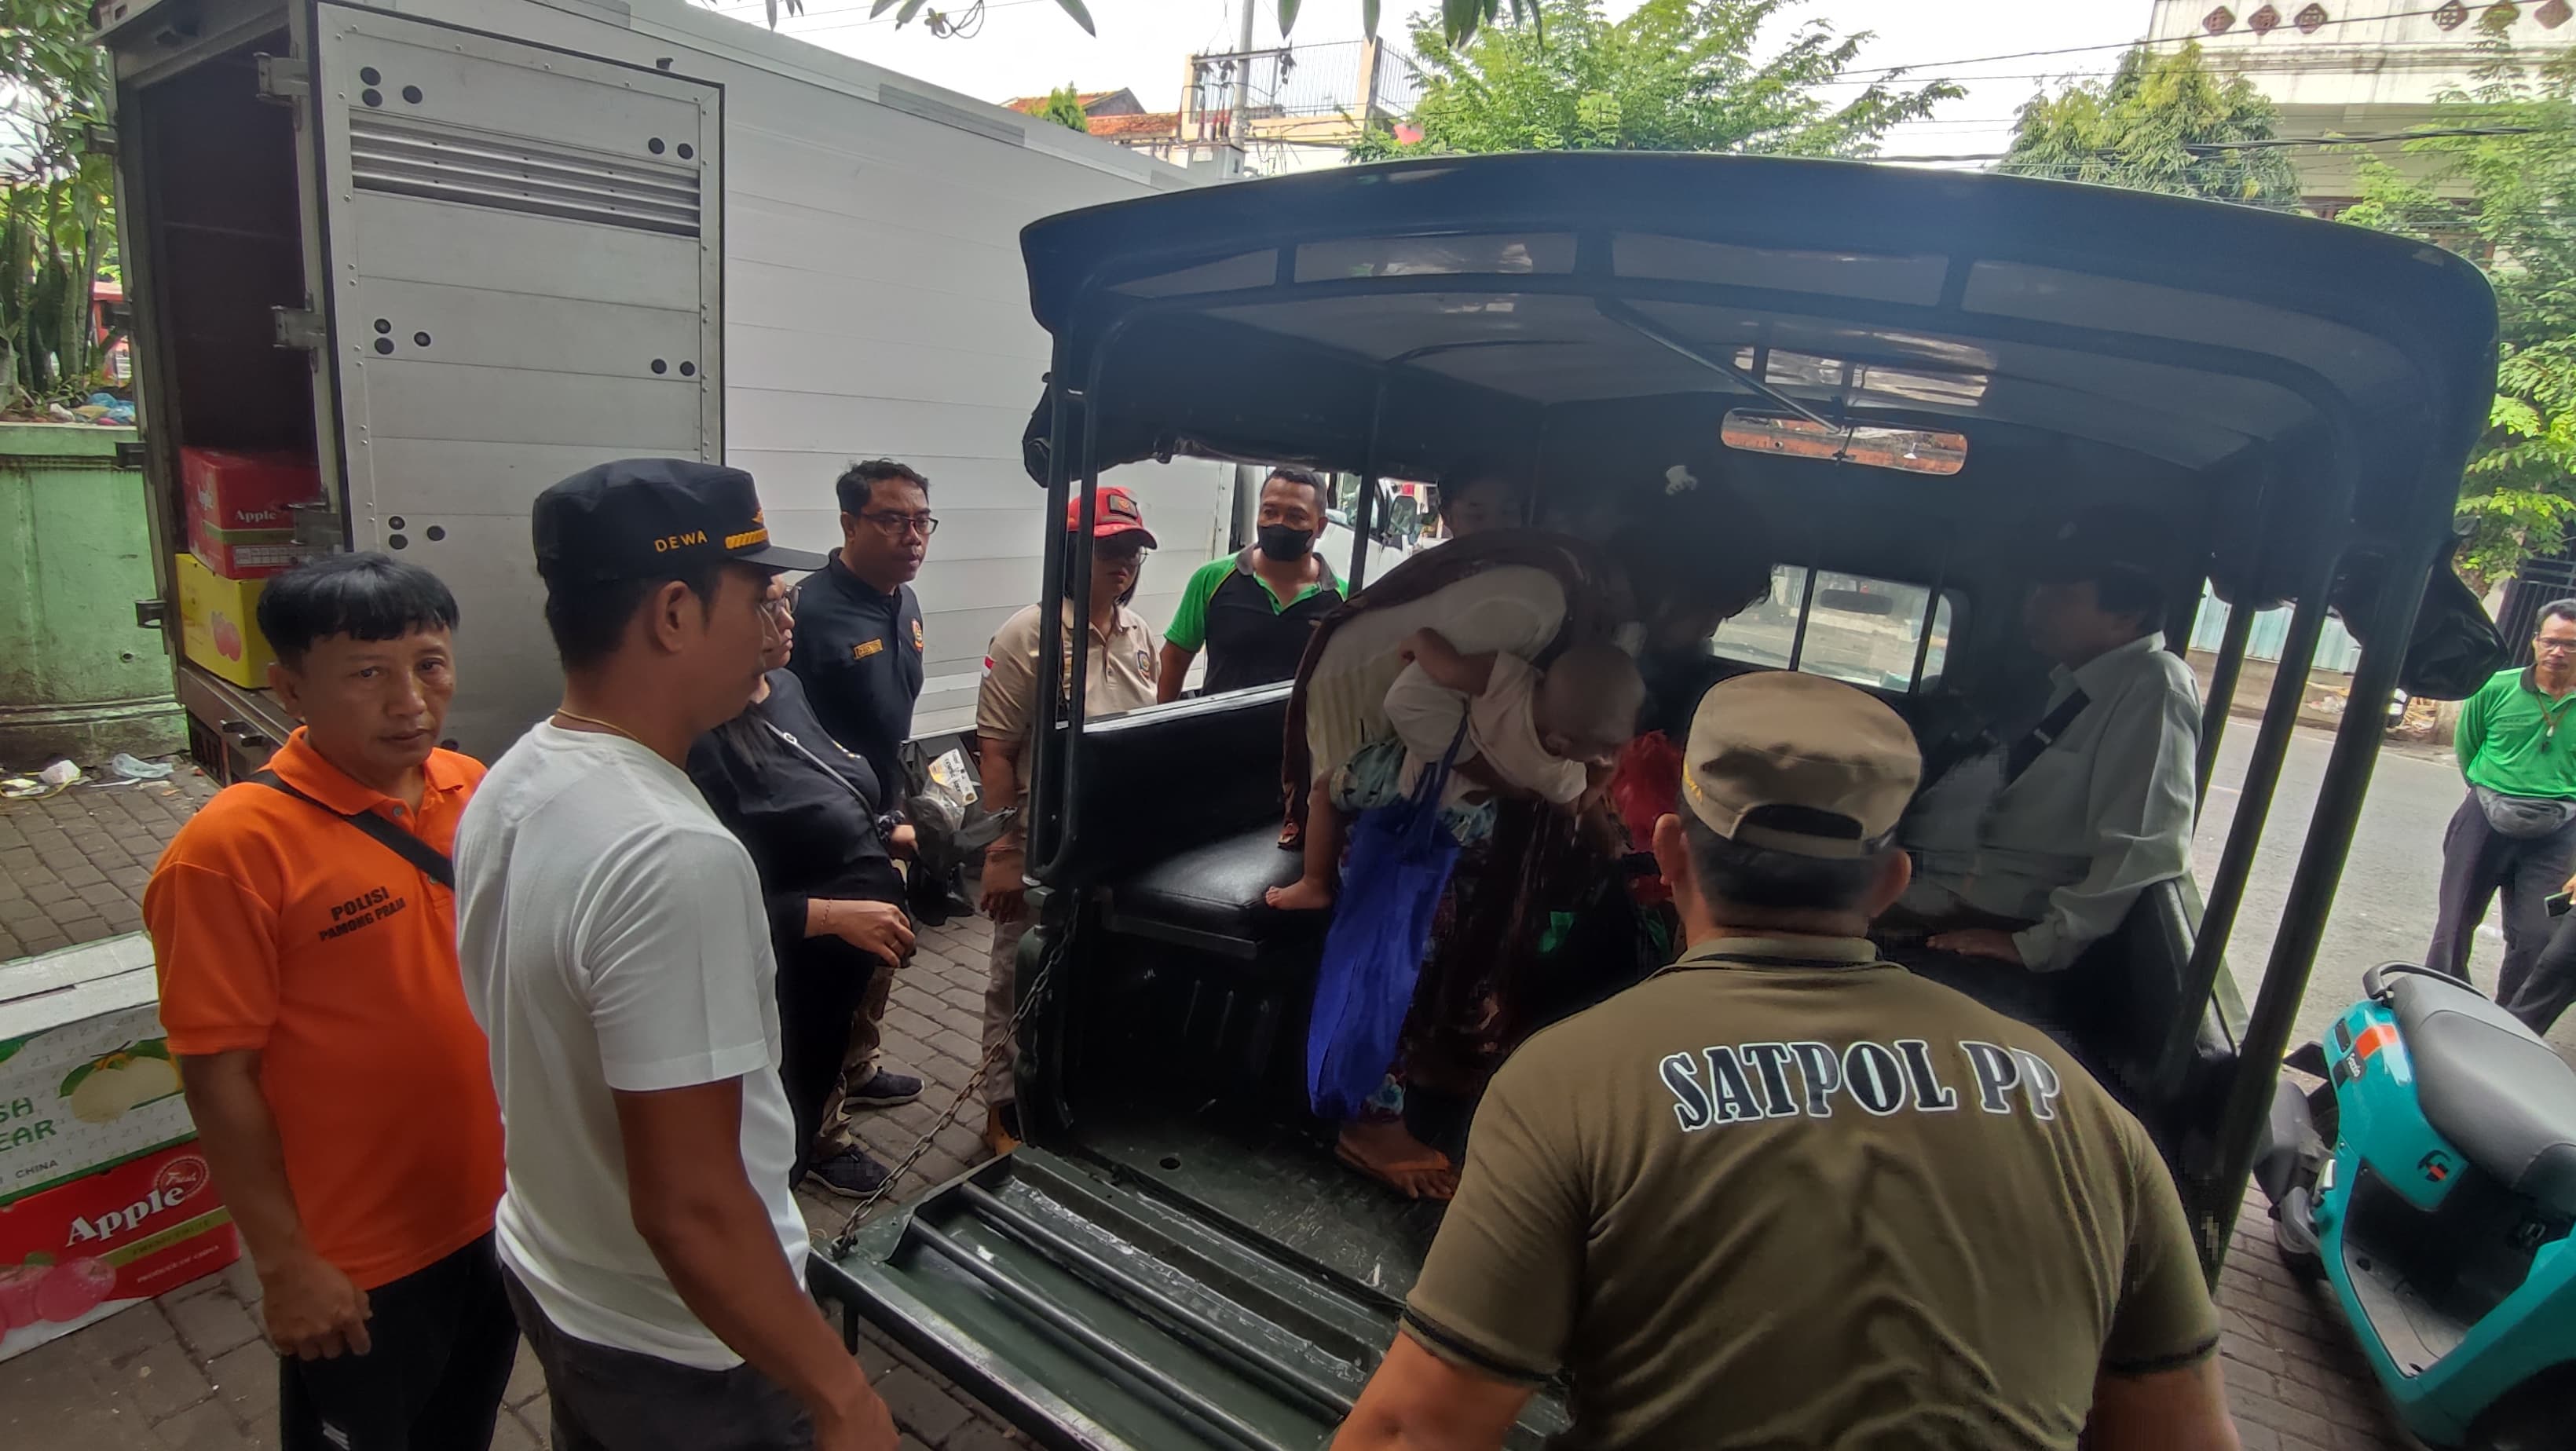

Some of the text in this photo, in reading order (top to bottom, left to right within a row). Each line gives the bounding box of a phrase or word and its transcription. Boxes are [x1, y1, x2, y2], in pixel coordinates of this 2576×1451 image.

[235, 510, 276, 523] Apple
[653, 530, 708, 553] DEWA
[331, 886, 390, 922] POLISI
[318, 912, 375, 941] PAMONG
[1659, 1040, 2061, 1132] SATPOL PP
[15, 1160, 59, 1179] CHINA
[65, 1186, 185, 1248] Apple
